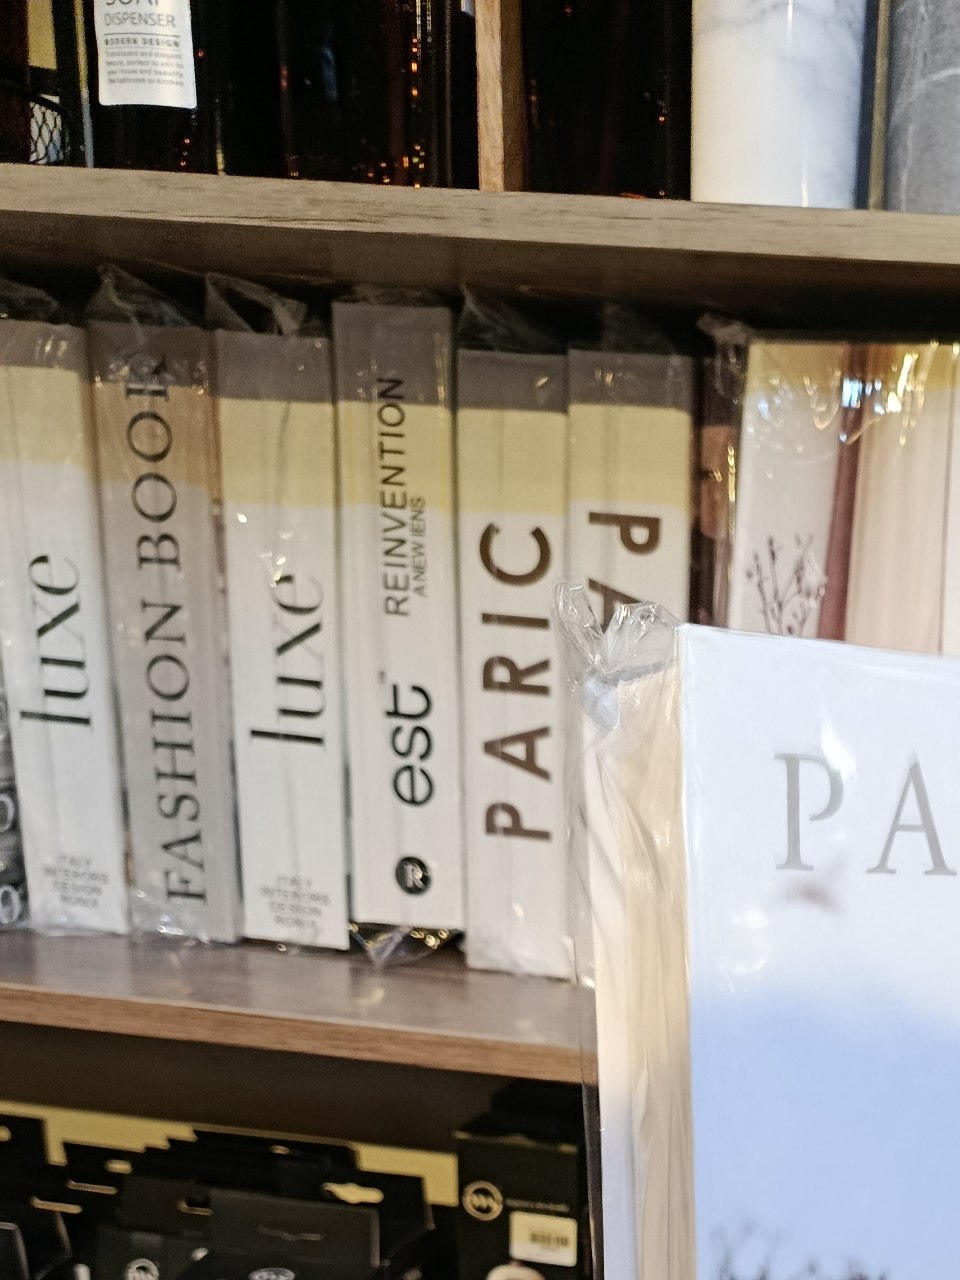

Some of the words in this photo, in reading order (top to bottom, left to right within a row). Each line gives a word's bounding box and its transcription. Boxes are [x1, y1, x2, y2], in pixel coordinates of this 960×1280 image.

[103, 11, 176, 28] DISPENSER
[377, 377, 411, 617] REINVENTION
[411, 541, 428, 582] NEW
[20, 554, 92, 728] luxe
[250, 573, 326, 748] luxe
[479, 522, 552, 842] PARIC
[141, 599, 208, 905] FASHION
